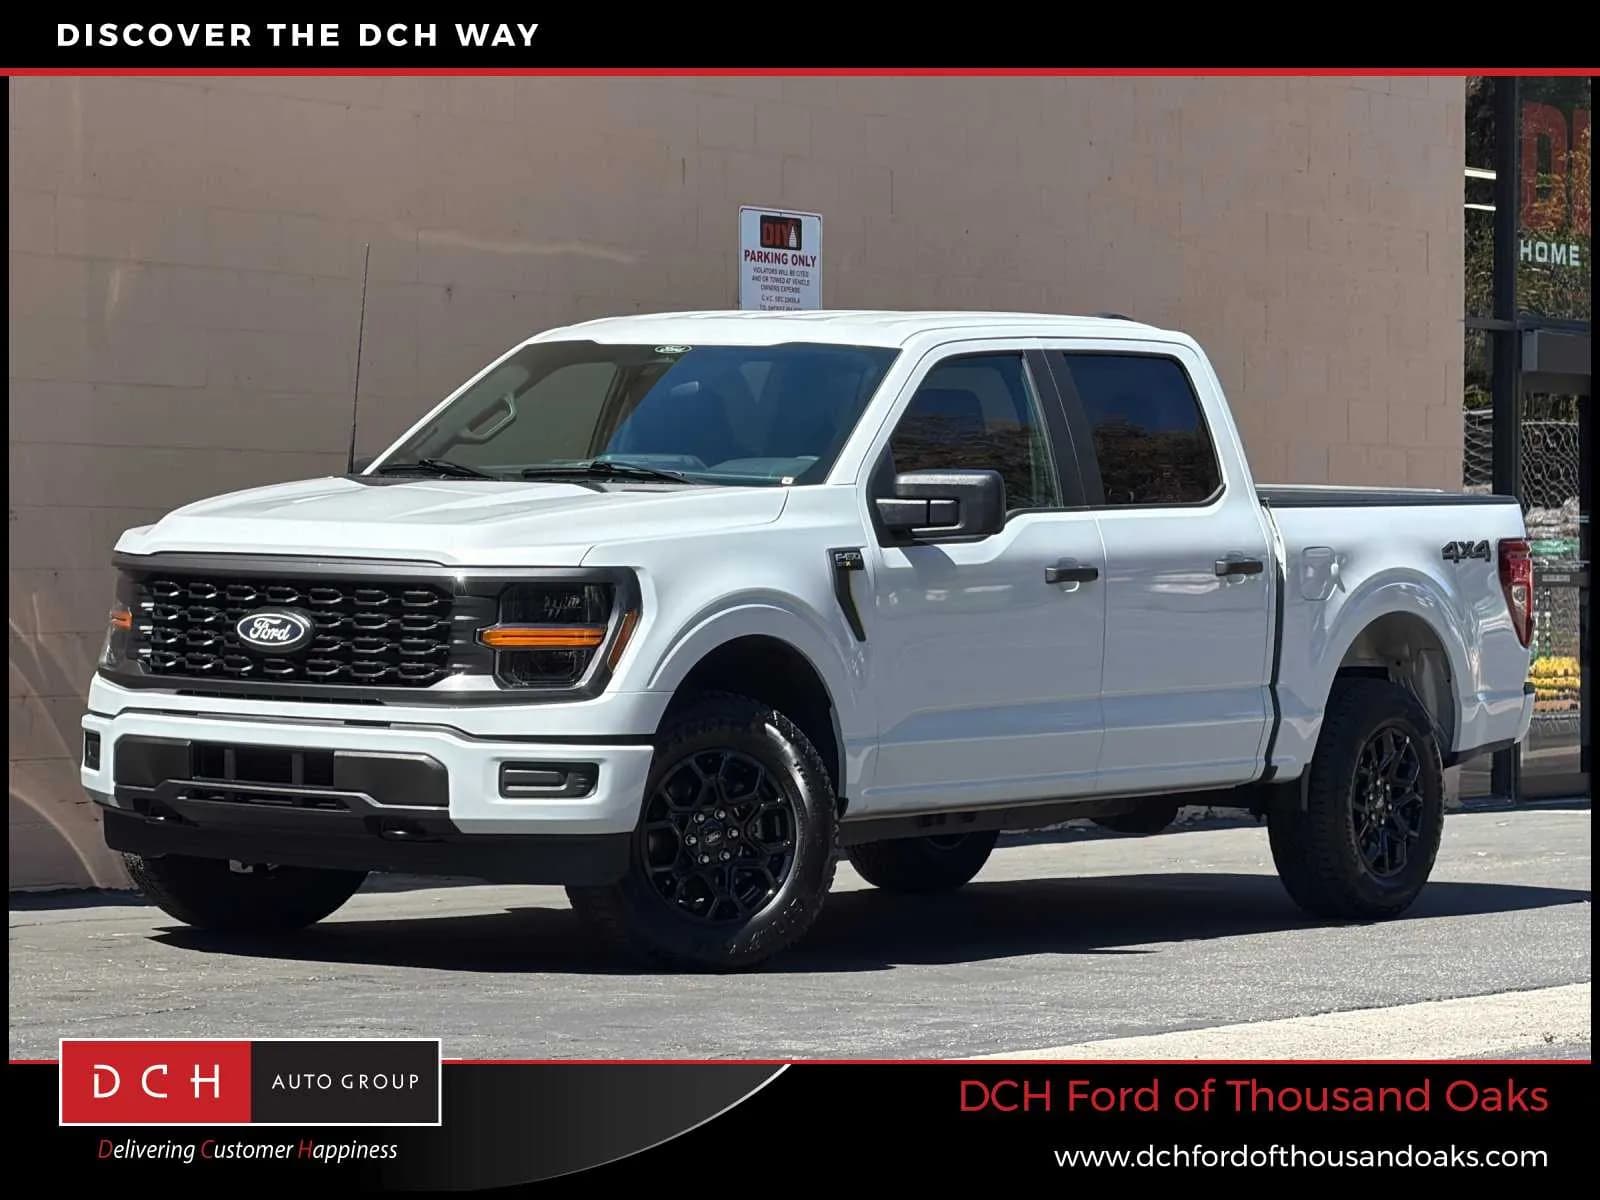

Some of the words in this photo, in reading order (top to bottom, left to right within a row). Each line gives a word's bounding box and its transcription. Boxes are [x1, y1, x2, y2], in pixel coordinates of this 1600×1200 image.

[744, 249, 789, 266] PARKING
[791, 253, 817, 268] ONLY
[1519, 239, 1582, 267] HOME
[753, 266, 778, 275] VIOLATORS
[778, 268, 788, 276] WILL
[769, 276, 786, 285] TOWED
[791, 278, 810, 287] VEHICLE
[249, 617, 292, 641] Ford
